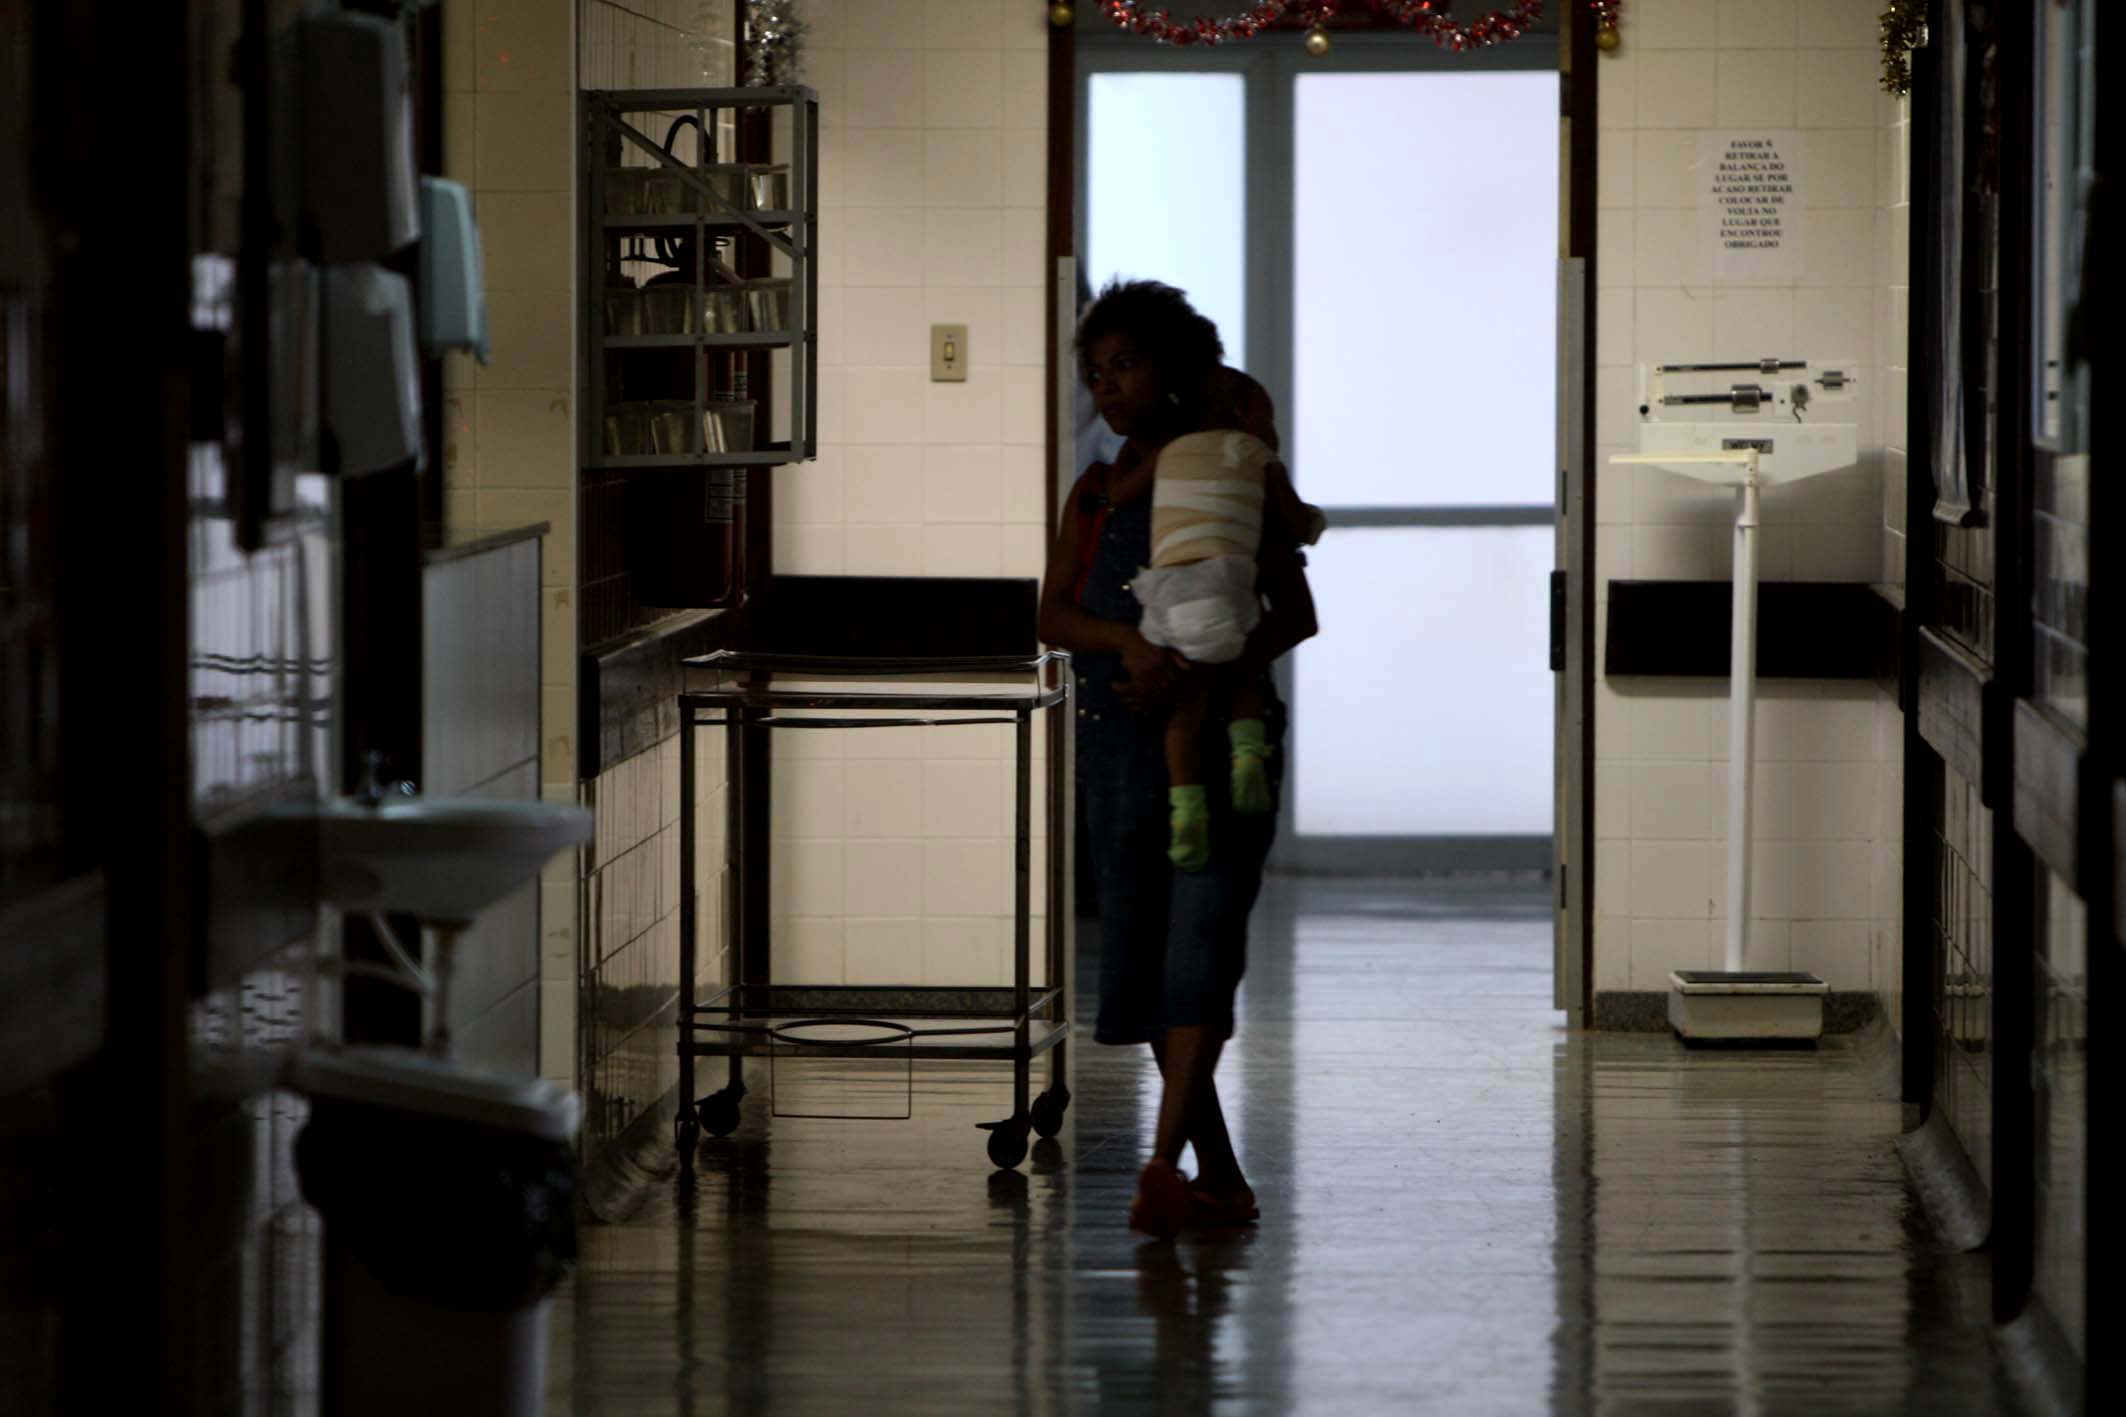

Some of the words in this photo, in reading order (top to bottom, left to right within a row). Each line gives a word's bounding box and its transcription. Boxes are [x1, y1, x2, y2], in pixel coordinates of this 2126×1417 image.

[1730, 140, 1763, 148] FAVOR
[1725, 152, 1770, 160] RETIRAR
[1773, 152, 1779, 160] A
[1719, 163, 1768, 173] BALANÇA
[1769, 163, 1784, 171] DO
[1715, 174, 1751, 182] LUGAR
[1753, 174, 1764, 182] SE
[1767, 174, 1788, 182] POR
[1712, 185, 1745, 193] ACASO
[1748, 185, 1792, 193] RETIRAR
[1718, 196, 1769, 204] COLOCAR
[1771, 196, 1784, 204] DE
[1727, 207, 1759, 215] VOLTA
[1761, 207, 1777, 215] NO
[1722, 218, 1757, 226] LUGAR
[1760, 218, 1780, 226] QUE
[1724, 240, 1779, 248] OBRIGADO
